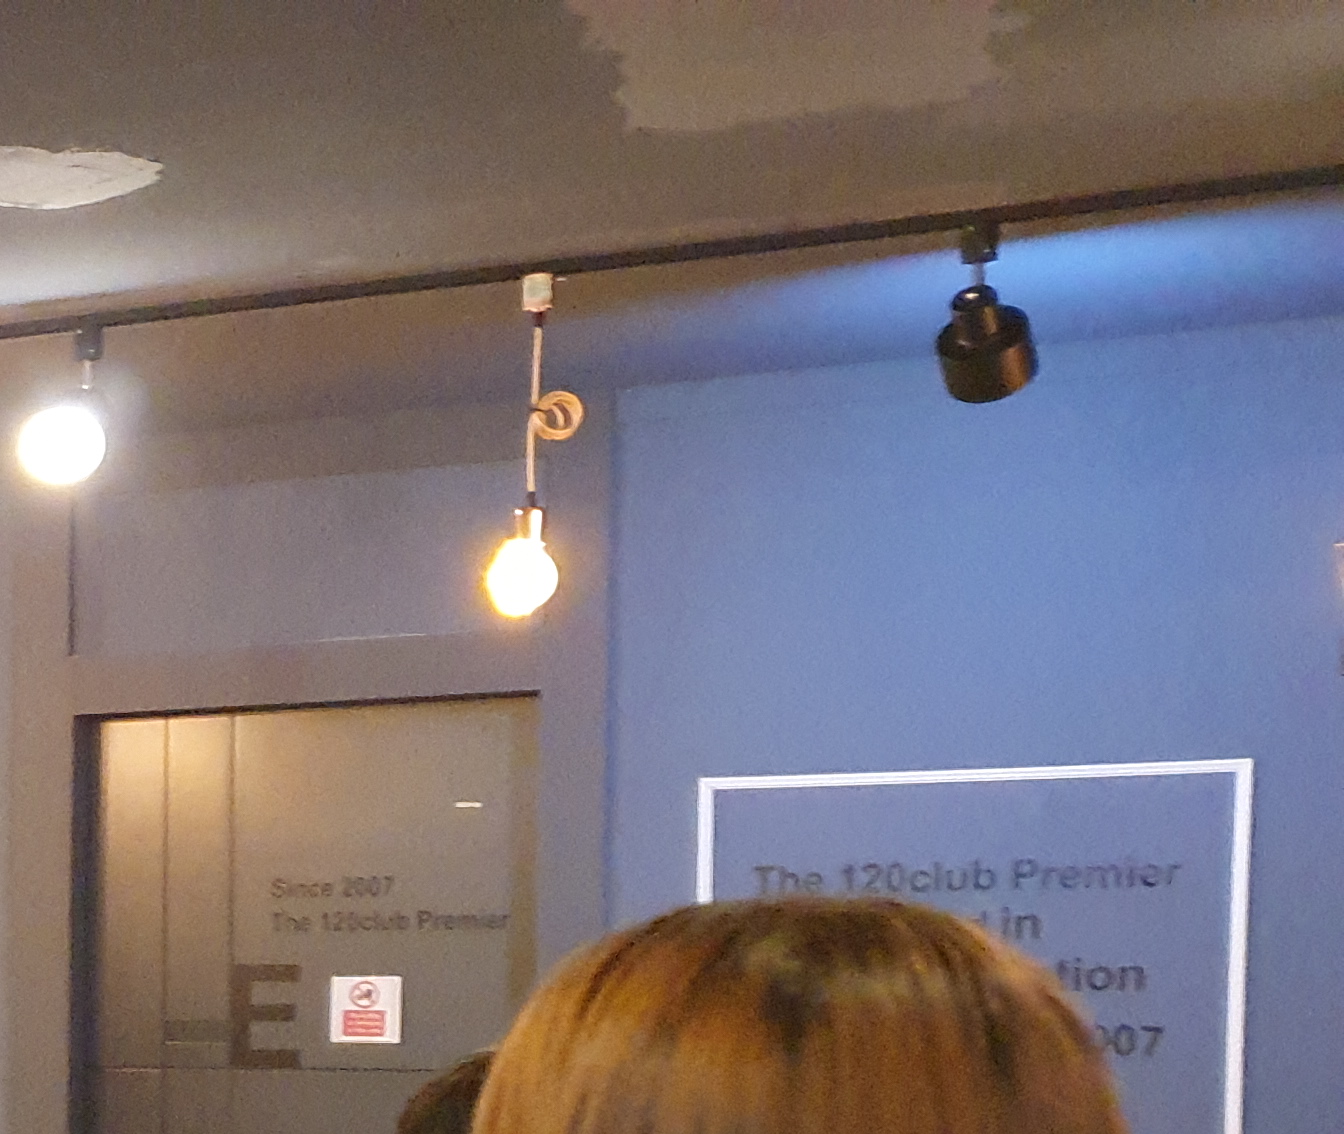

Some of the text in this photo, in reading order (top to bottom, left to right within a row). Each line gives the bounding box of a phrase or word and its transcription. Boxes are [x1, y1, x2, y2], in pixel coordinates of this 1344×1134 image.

[753, 857, 1182, 893] The 120club Premier
[1000, 906, 1044, 941] in
[1057, 957, 1148, 992] tion
